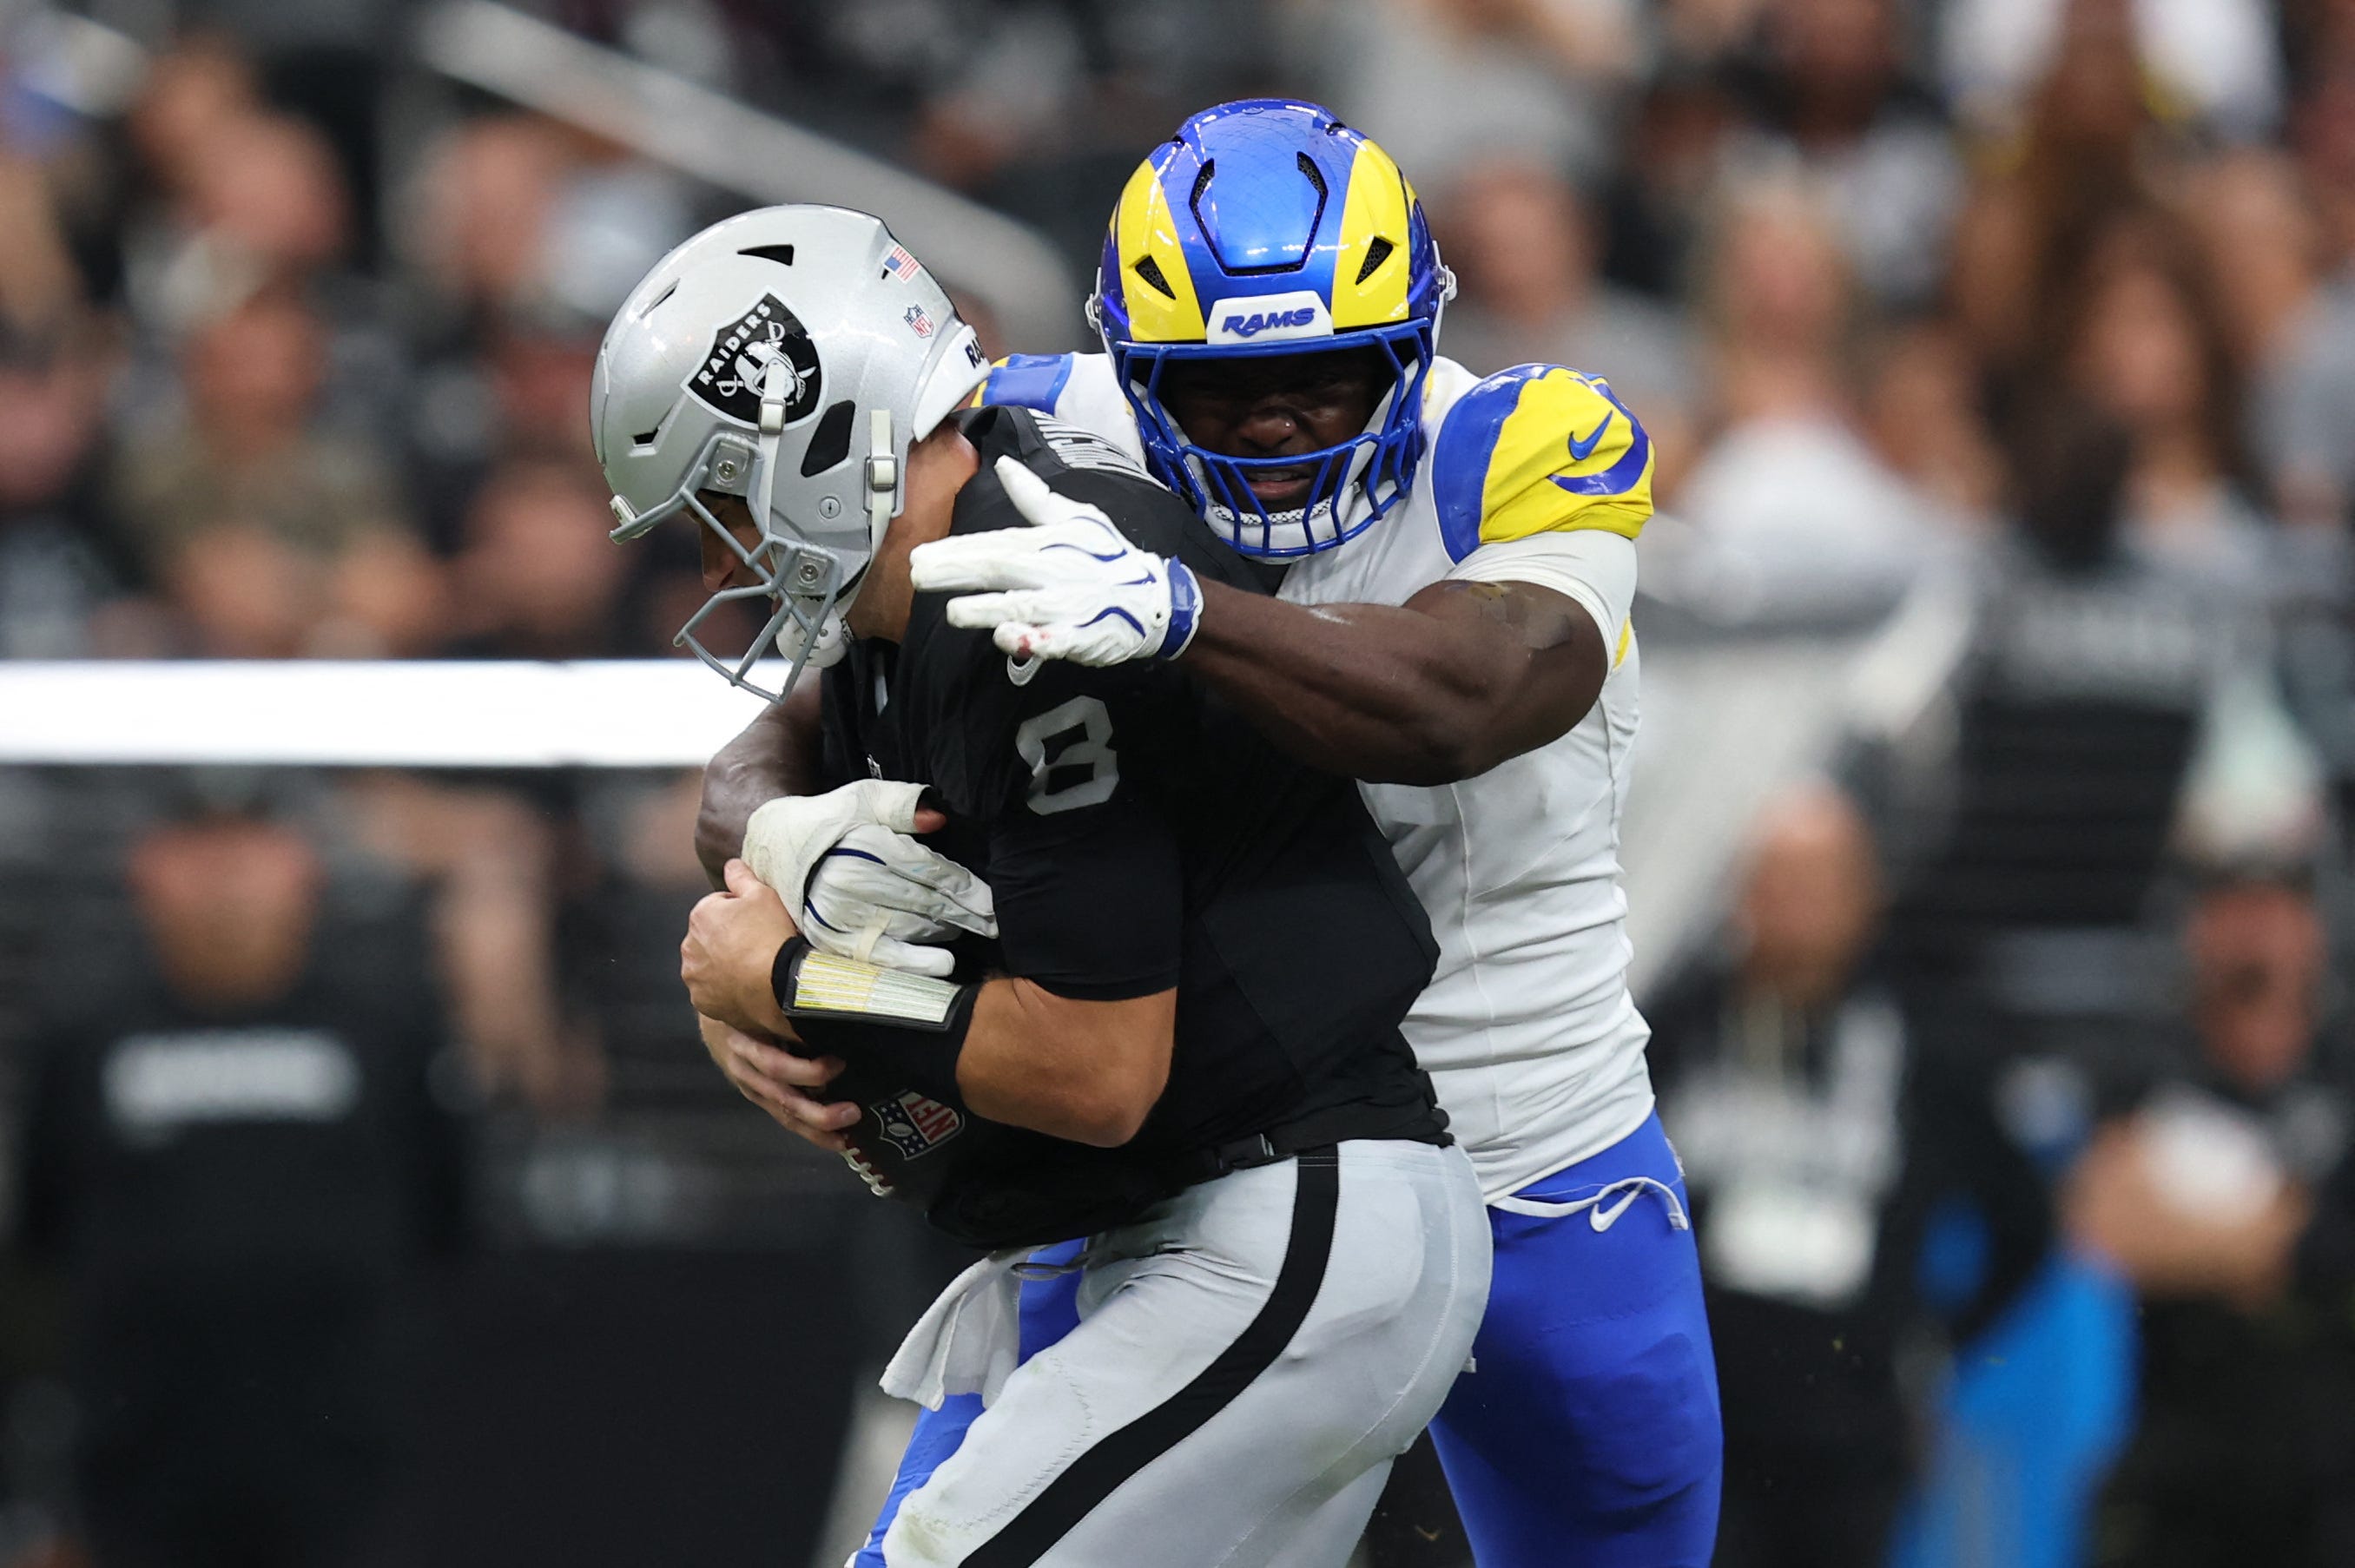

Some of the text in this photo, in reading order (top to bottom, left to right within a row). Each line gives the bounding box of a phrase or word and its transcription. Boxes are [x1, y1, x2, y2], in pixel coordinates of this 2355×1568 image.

[697, 303, 771, 386] RAIDERS
[913, 316, 933, 336] NFL
[1221, 307, 1316, 338] RAMS
[1015, 695, 1120, 815] 8
